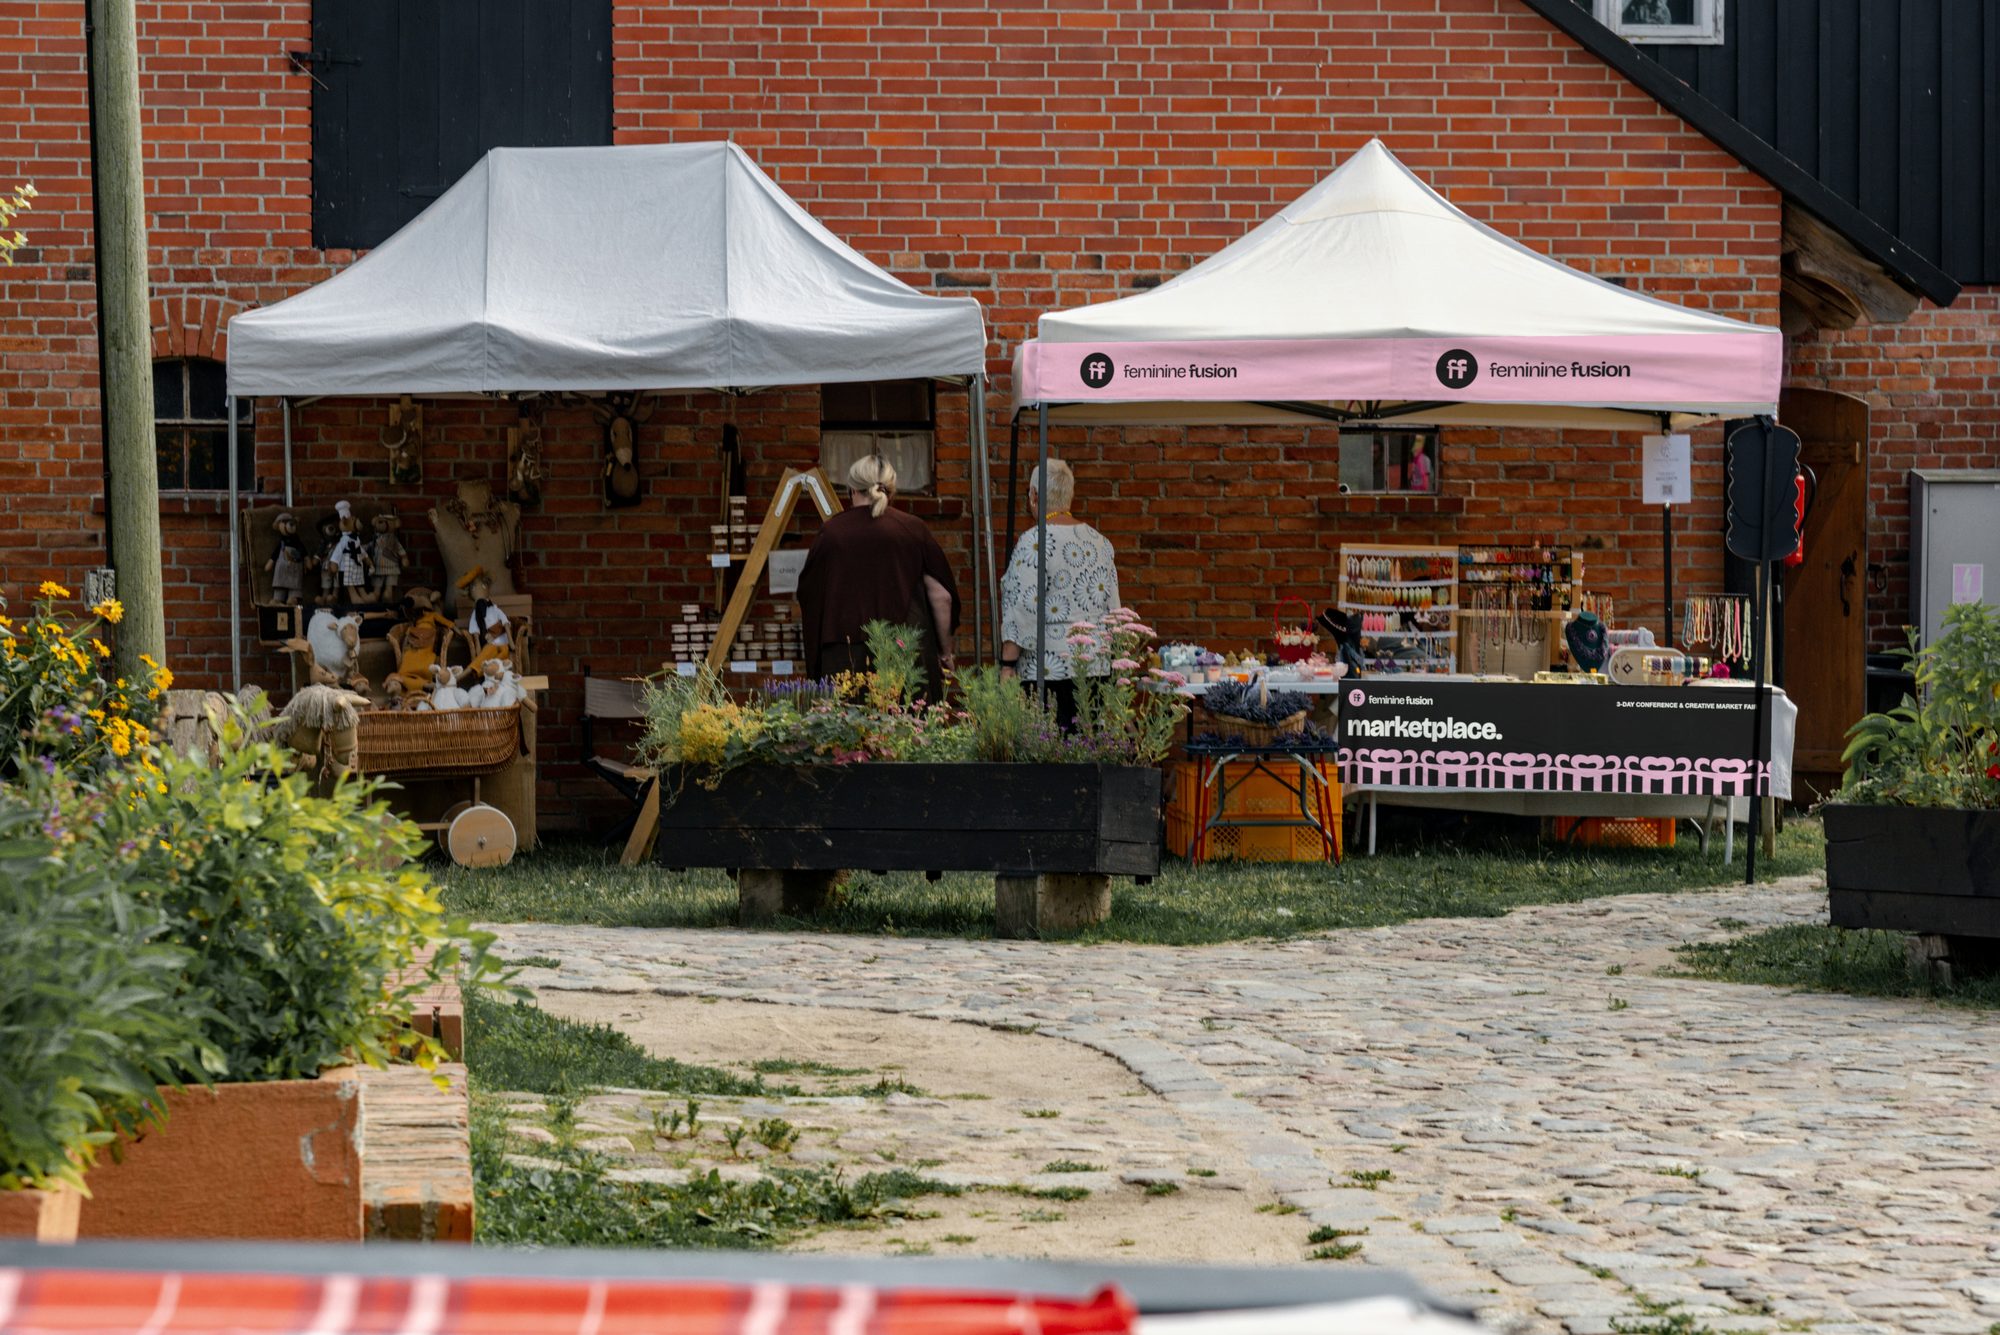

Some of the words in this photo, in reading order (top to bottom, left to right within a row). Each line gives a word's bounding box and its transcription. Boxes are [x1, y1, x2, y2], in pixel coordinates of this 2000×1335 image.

[1088, 361, 1106, 380] ff
[1124, 364, 1187, 379] feminine
[1188, 363, 1238, 379] fusion
[1446, 358, 1468, 380] ff
[1489, 362, 1567, 378] feminine
[1570, 361, 1631, 378] fusion
[1368, 695, 1405, 705] feminine
[1405, 695, 1434, 706] fusion
[1635, 701, 1678, 709] CONFERENCE
[1347, 715, 1503, 742] marketplace.
